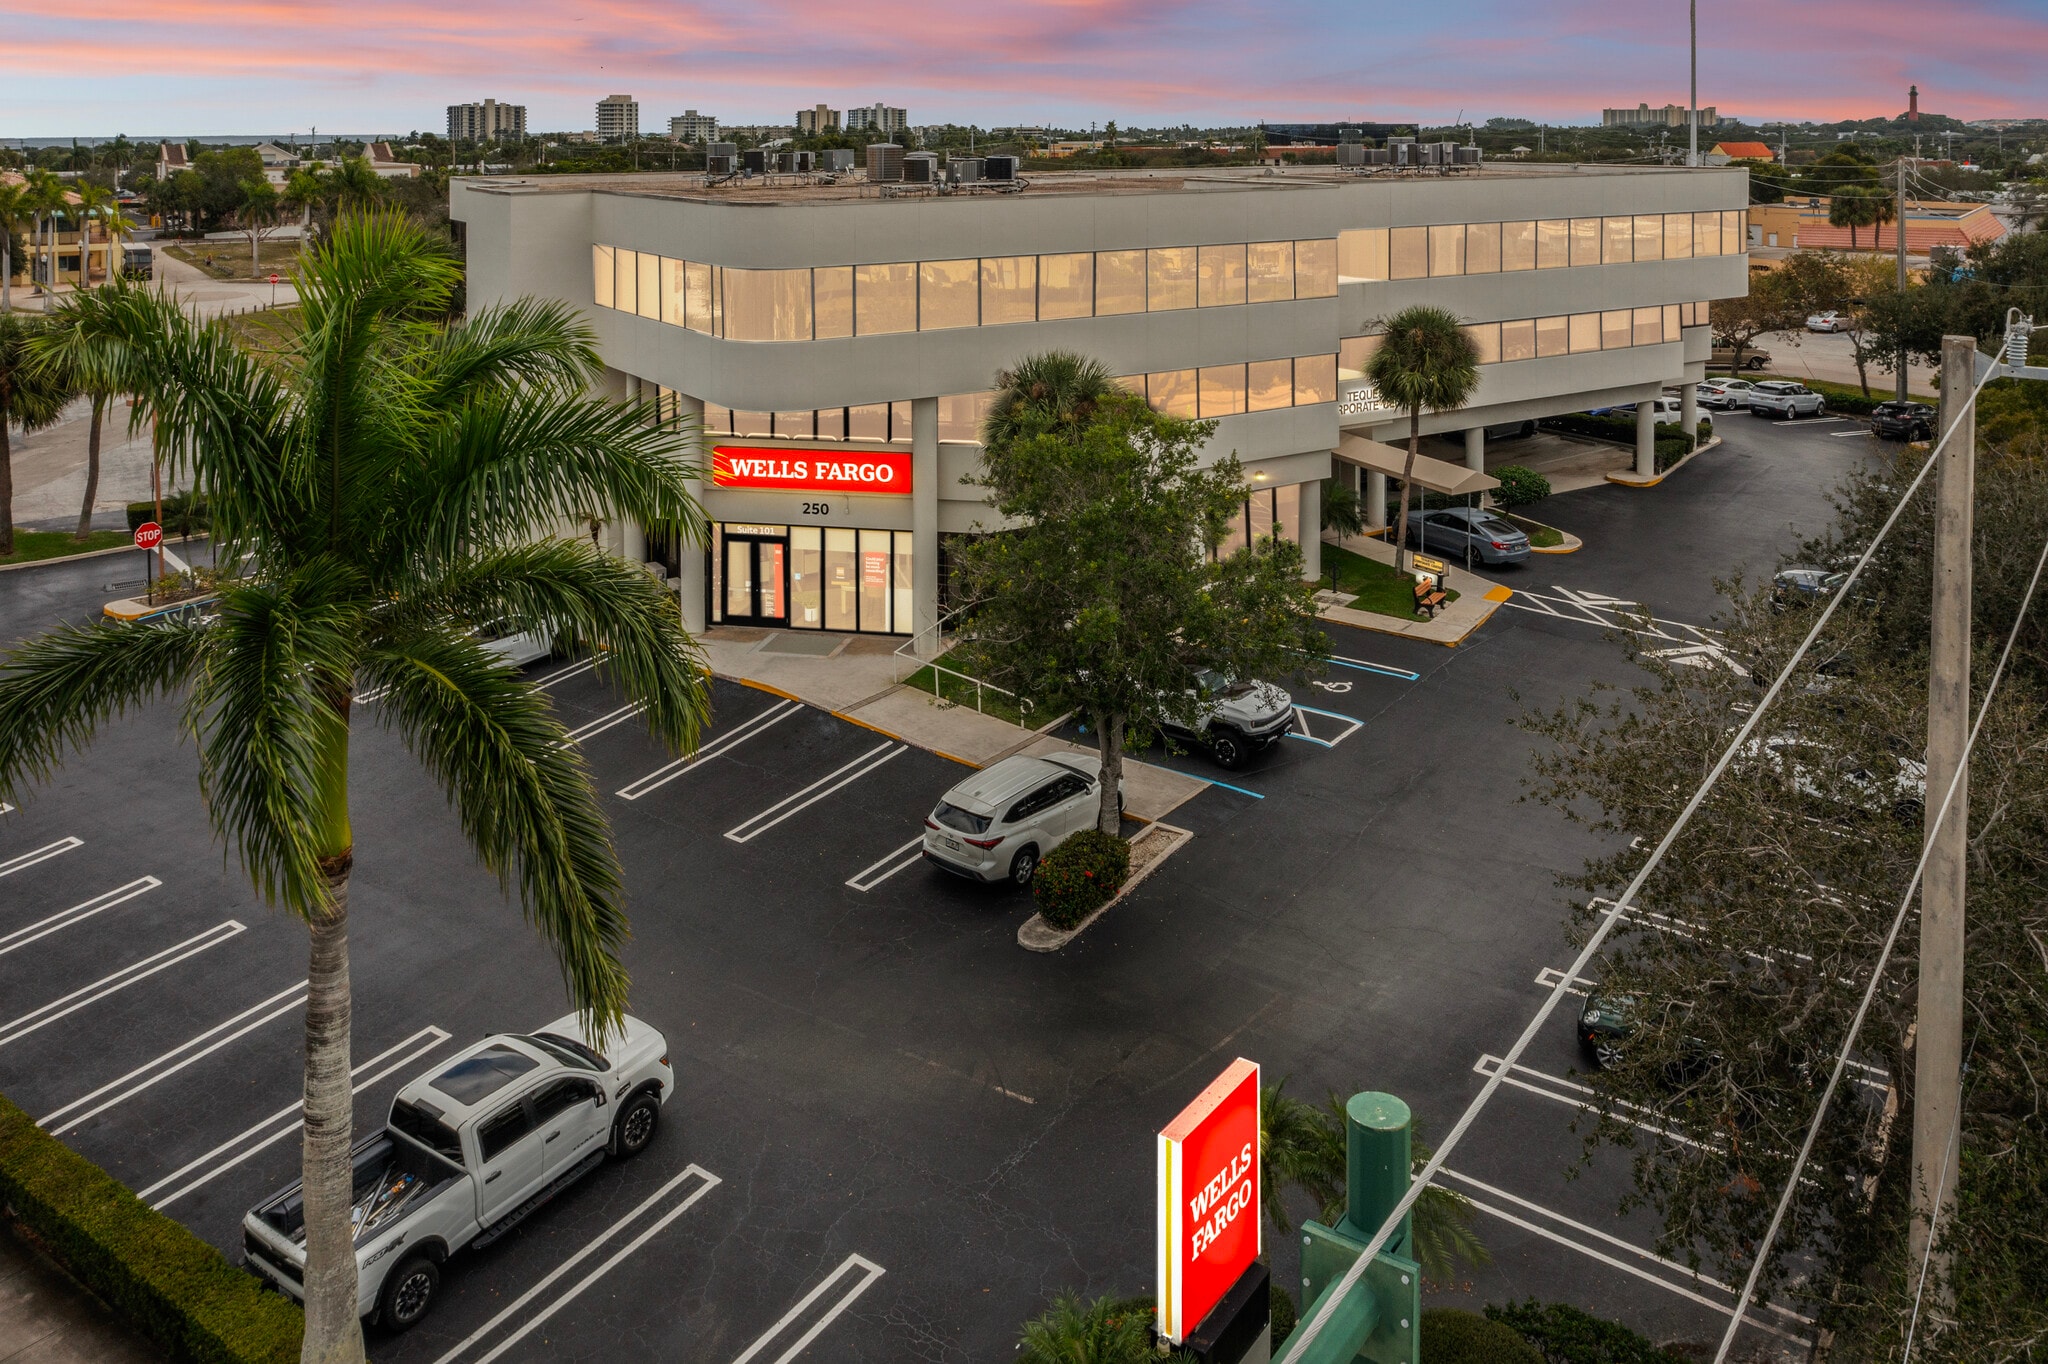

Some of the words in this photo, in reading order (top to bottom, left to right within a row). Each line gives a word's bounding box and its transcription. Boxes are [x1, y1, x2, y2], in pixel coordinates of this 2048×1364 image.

[1347, 389, 1381, 401] TEQUE
[730, 459, 807, 479] WELLS
[815, 462, 893, 482] FARGO
[802, 503, 829, 515] 250
[137, 530, 160, 543] STOP
[737, 525, 758, 534] Suite
[760, 527, 775, 535] 101
[1190, 1142, 1251, 1223] WELLS
[1192, 1179, 1252, 1262] FARGO
